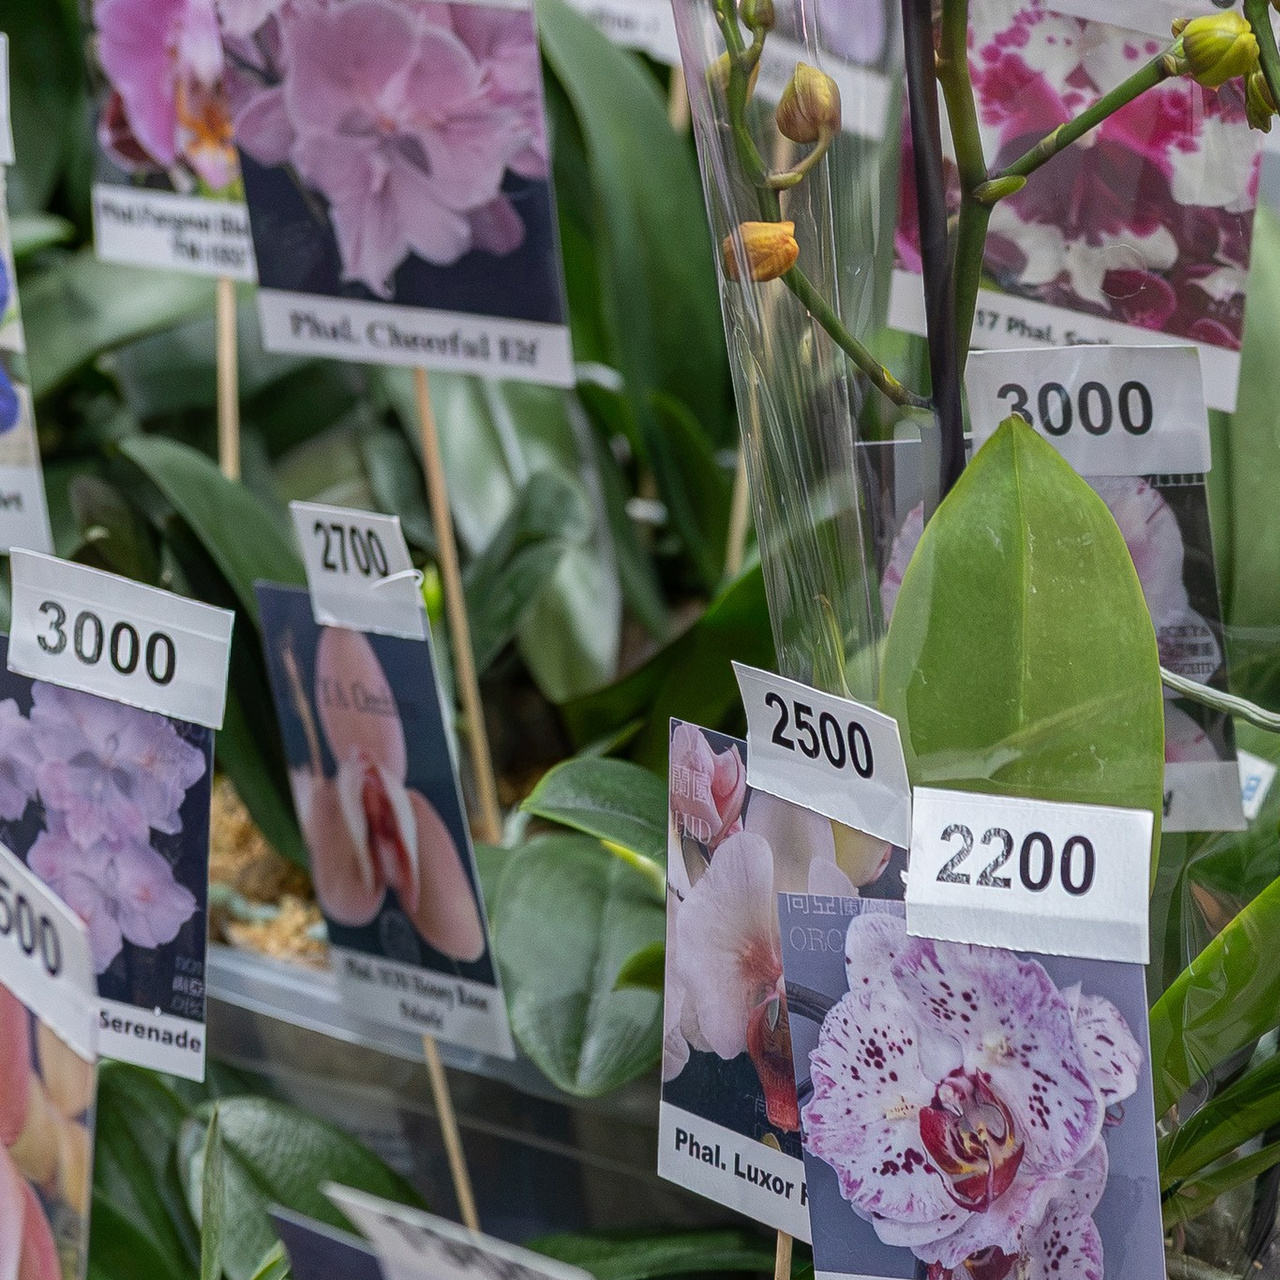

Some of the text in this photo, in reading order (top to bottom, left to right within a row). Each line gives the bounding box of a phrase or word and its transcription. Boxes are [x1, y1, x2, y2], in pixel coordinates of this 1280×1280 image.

[997, 380, 1153, 436] 3000
[314, 519, 391, 578] 2700
[37, 600, 176, 687] 3000
[764, 691, 874, 780] 2500
[936, 824, 1096, 896] 2200
[99, 1011, 200, 1054] Serenade
[675, 1127, 726, 1171] Phal.
[733, 1153, 794, 1199] Luxor
